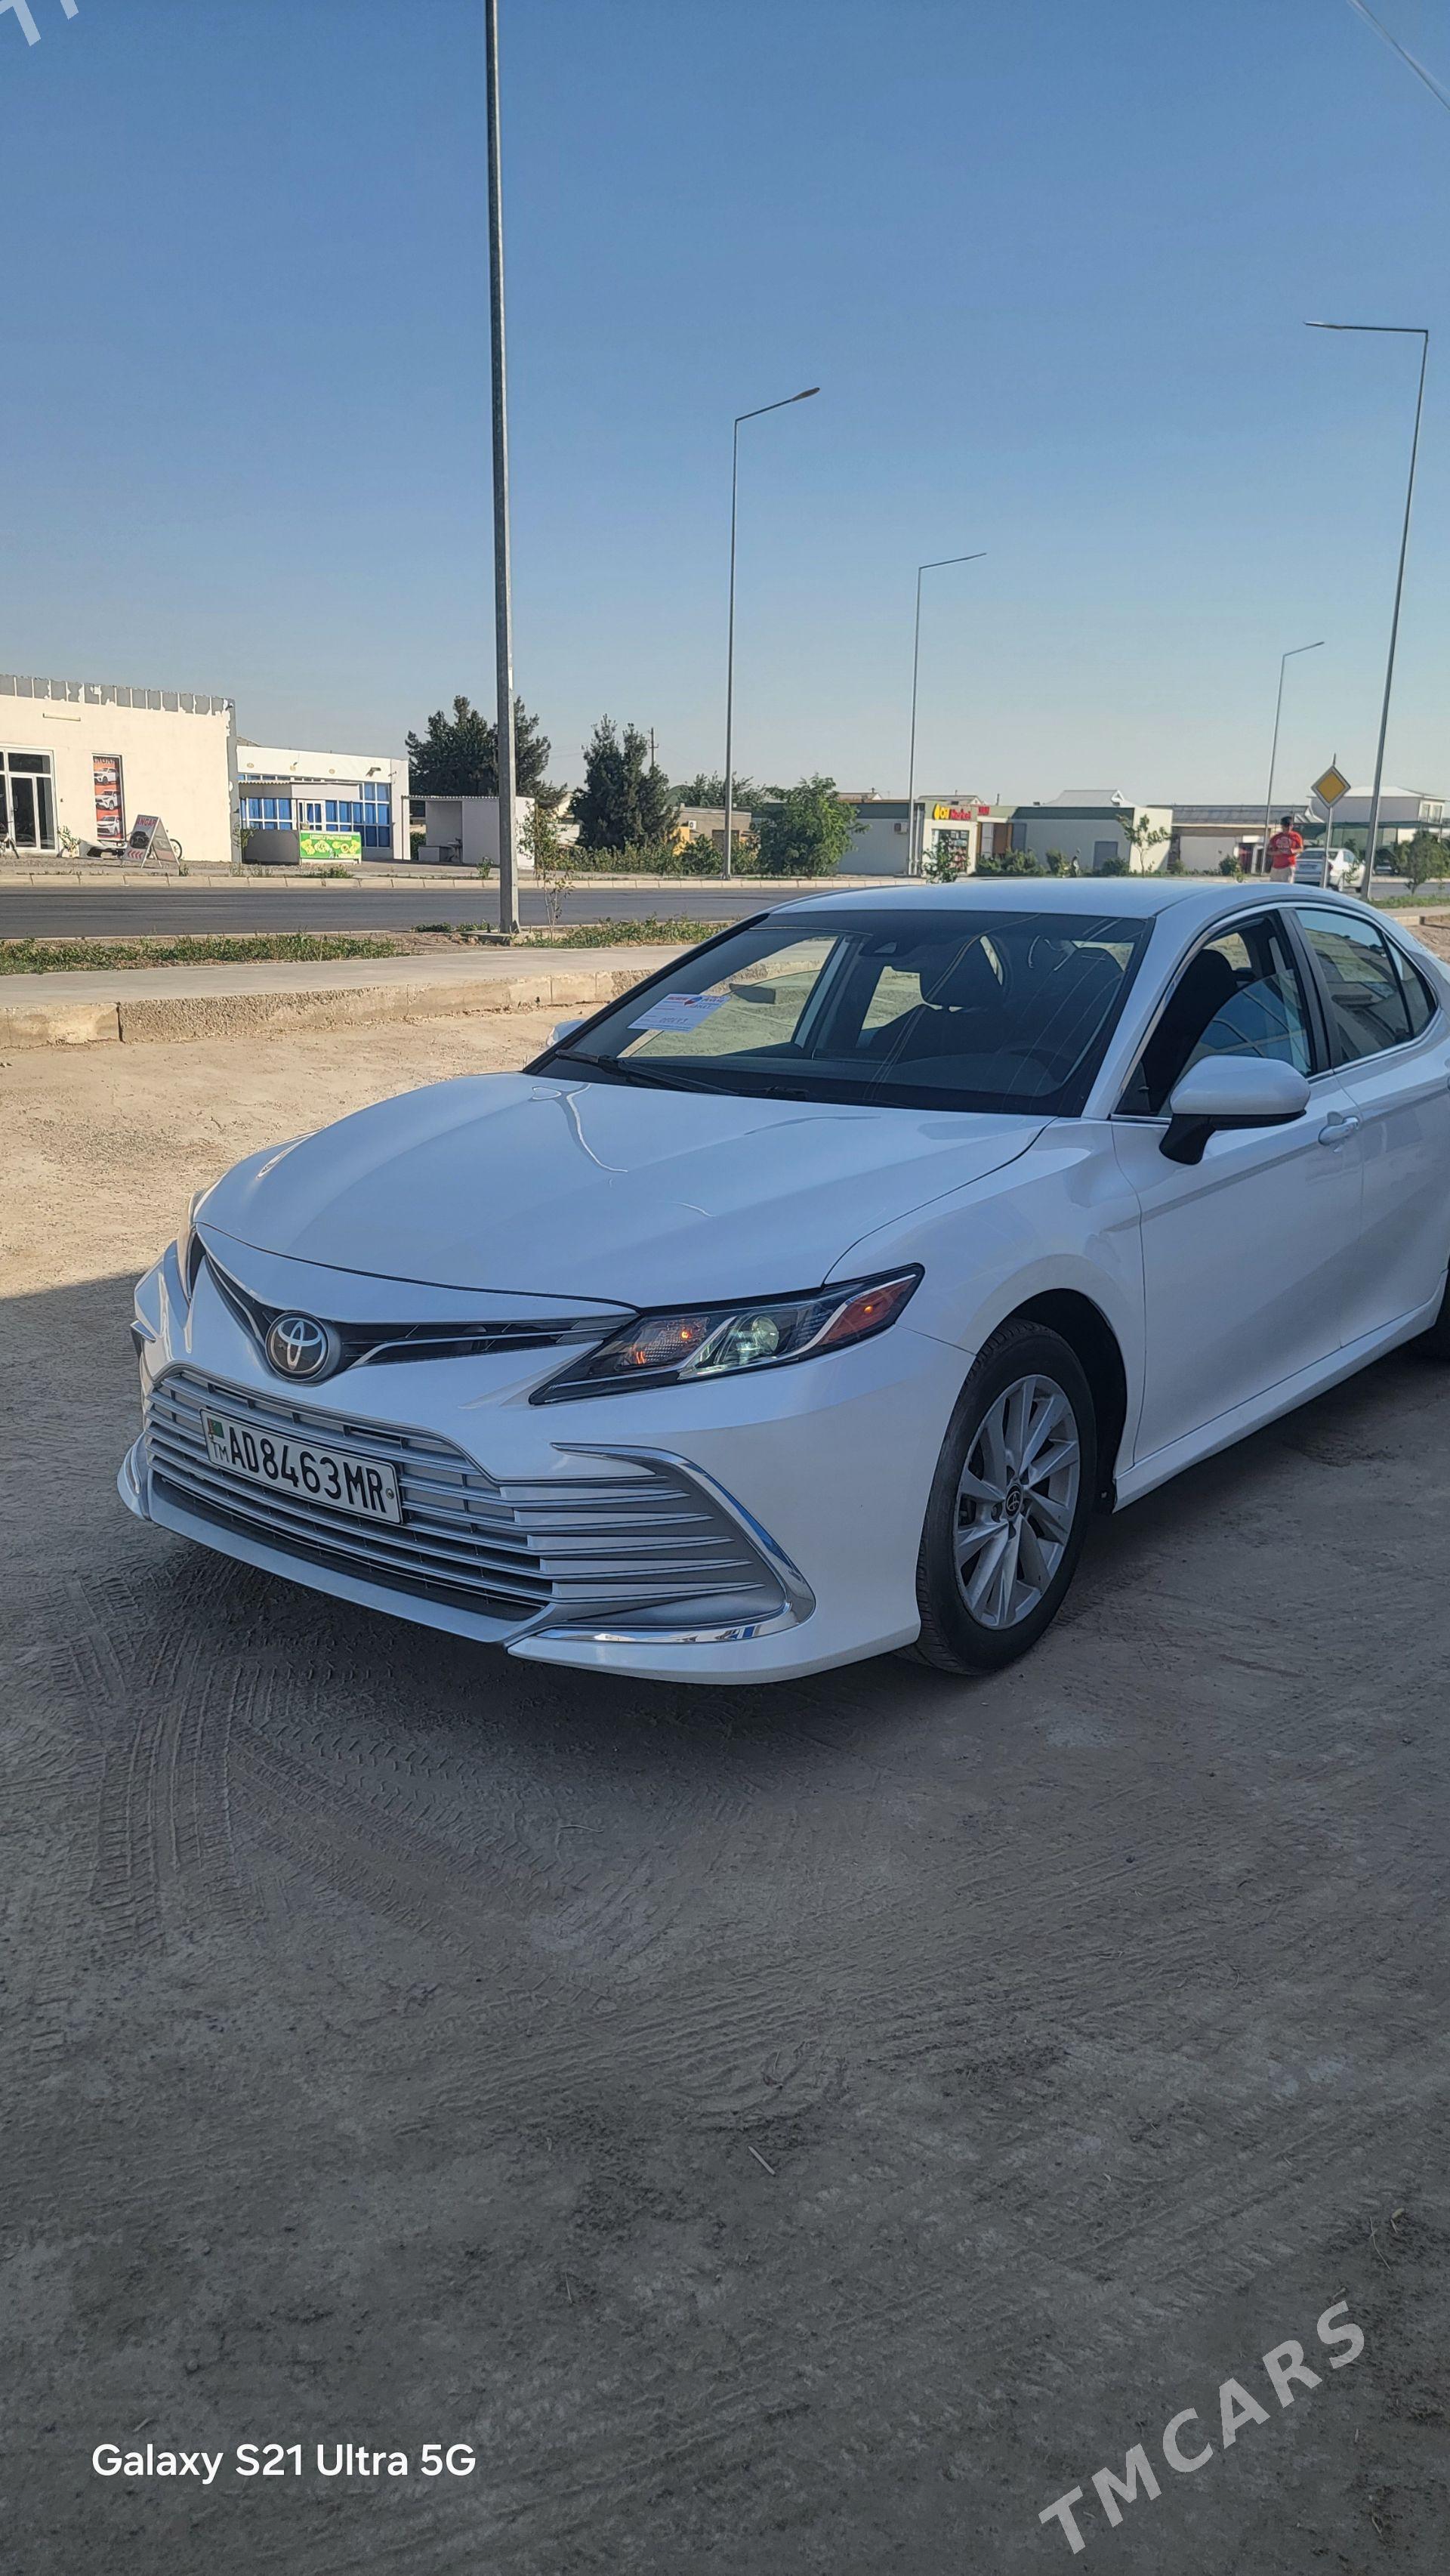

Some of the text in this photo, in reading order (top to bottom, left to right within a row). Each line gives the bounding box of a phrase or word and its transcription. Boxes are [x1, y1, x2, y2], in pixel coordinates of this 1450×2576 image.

[137, 817, 157, 827] ANGAR
[211, 1440, 229, 1463] TM
[229, 1425, 387, 1514] AD8463MR
